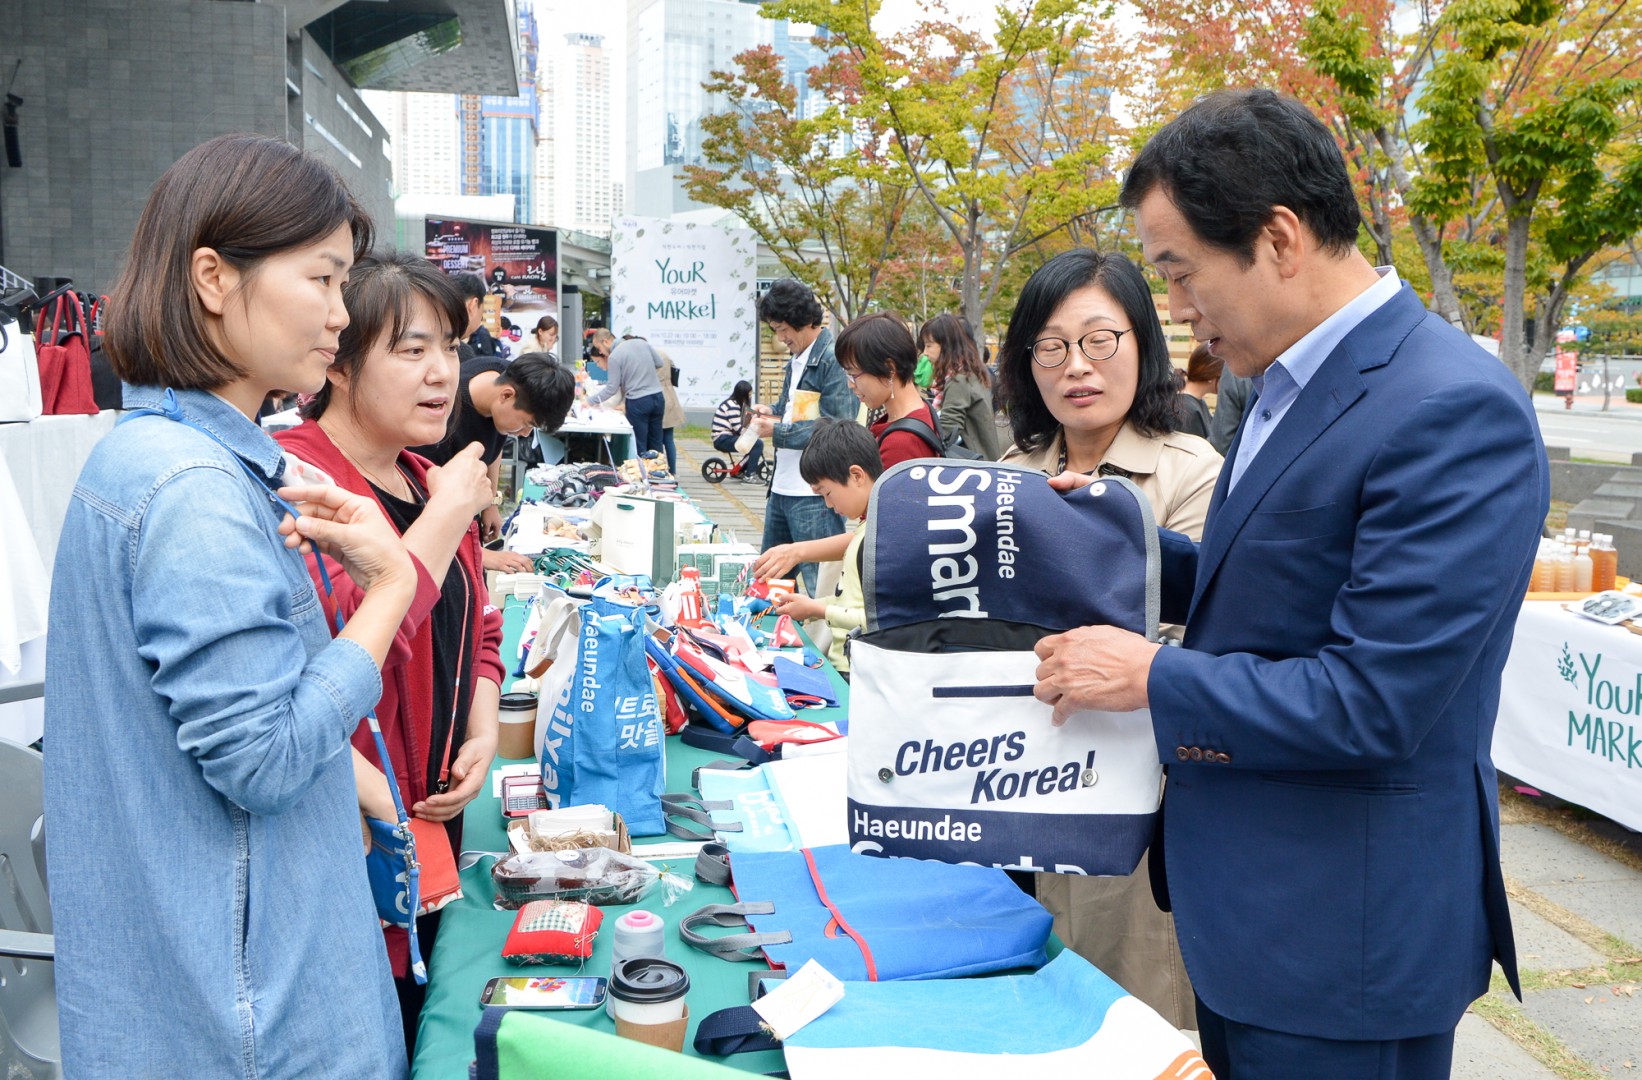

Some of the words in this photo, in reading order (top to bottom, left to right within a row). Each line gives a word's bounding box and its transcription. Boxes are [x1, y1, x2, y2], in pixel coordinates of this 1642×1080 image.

[996, 470, 1022, 579] Haeundae
[580, 610, 602, 714] Haeundae
[894, 730, 1027, 777] Cheers
[853, 809, 982, 842] Haeundae
